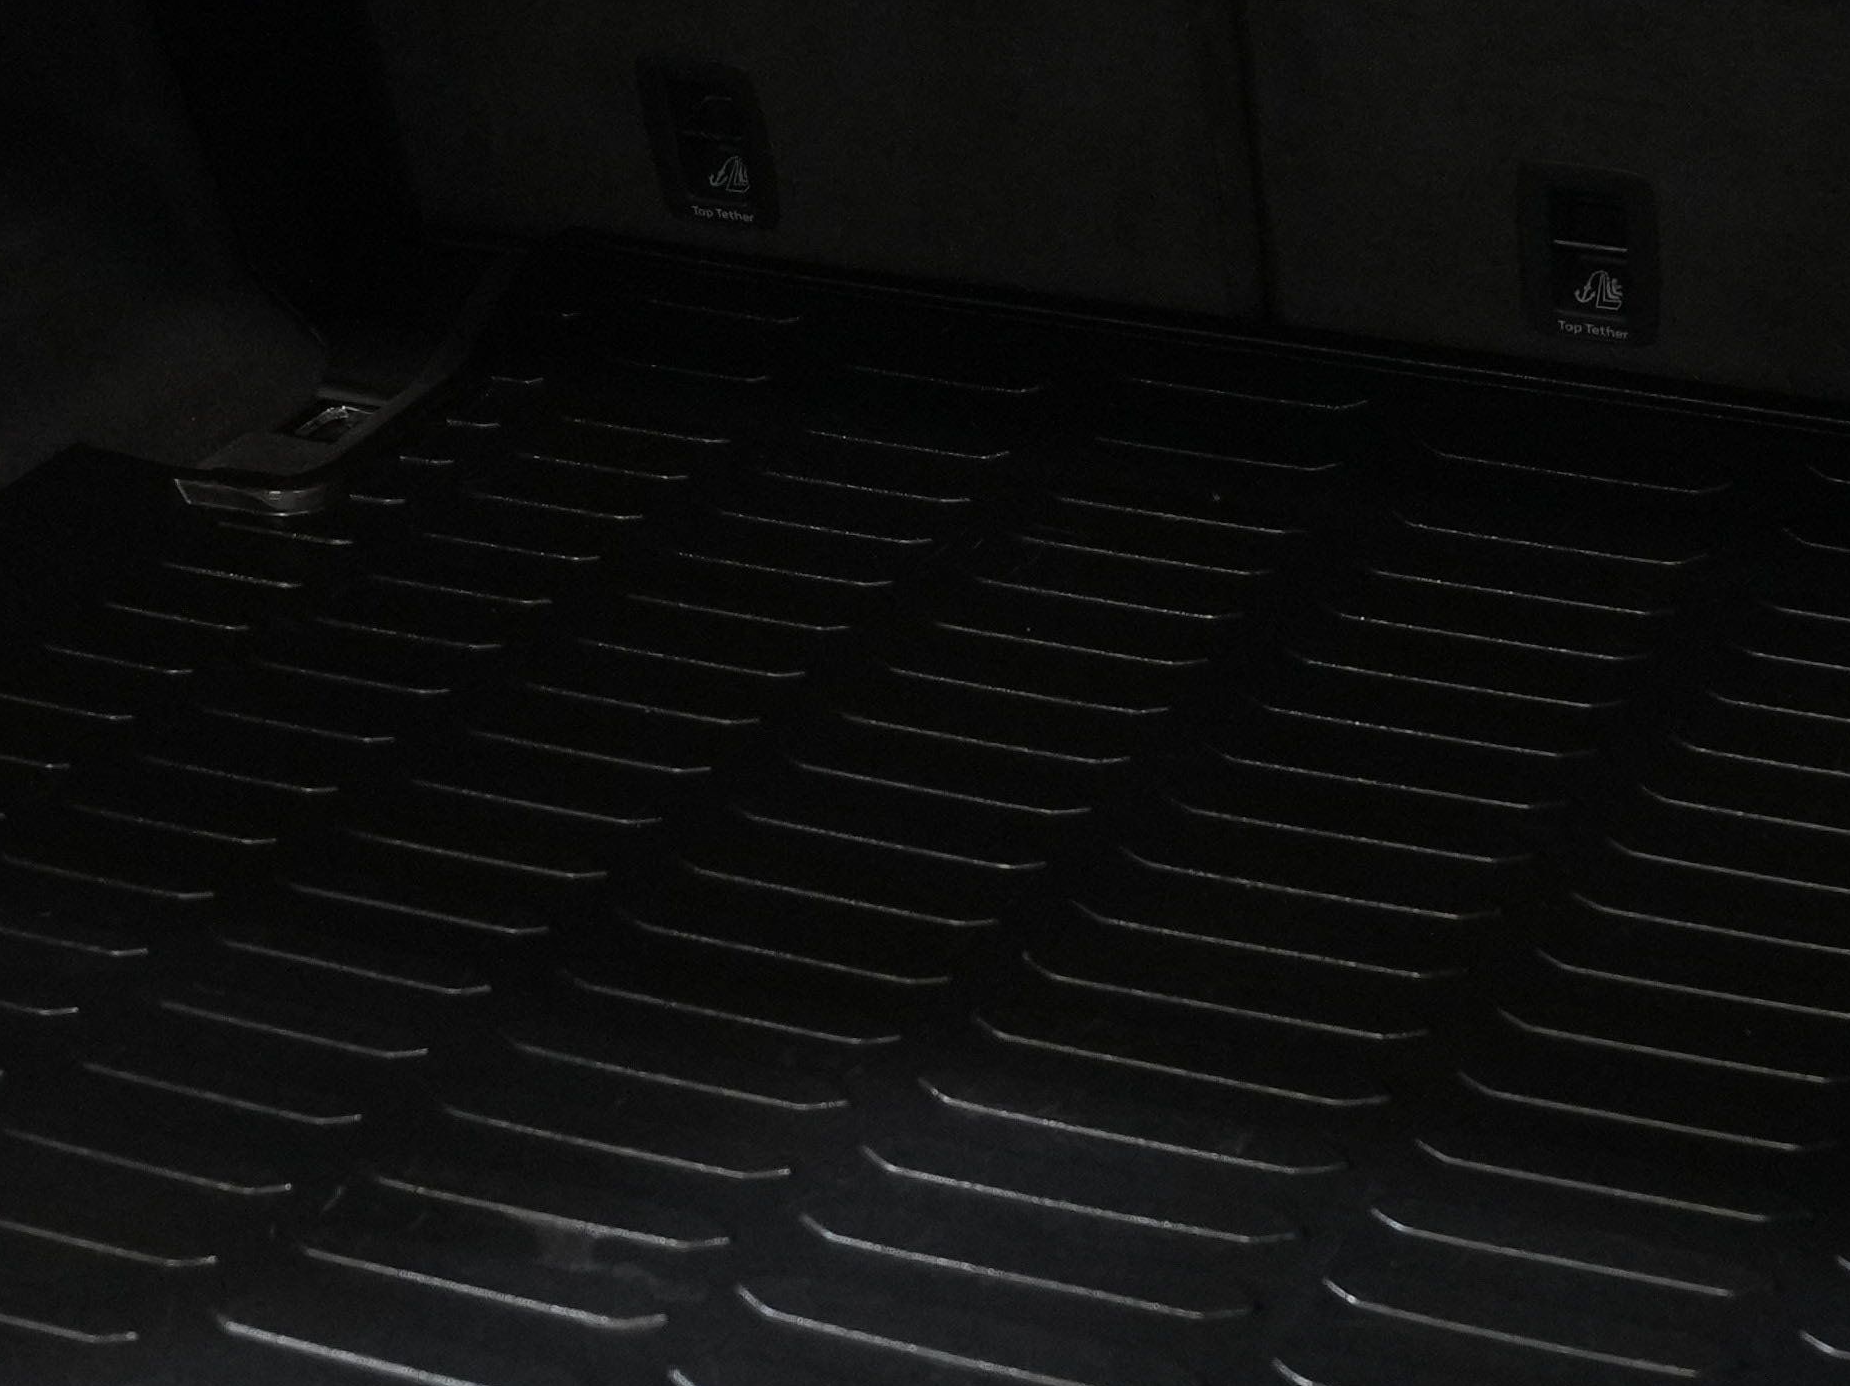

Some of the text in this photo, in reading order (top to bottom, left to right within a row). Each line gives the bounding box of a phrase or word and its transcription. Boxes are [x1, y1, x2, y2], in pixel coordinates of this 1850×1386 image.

[691, 206, 714, 219] Top
[1557, 320, 1629, 339] Top Tether
